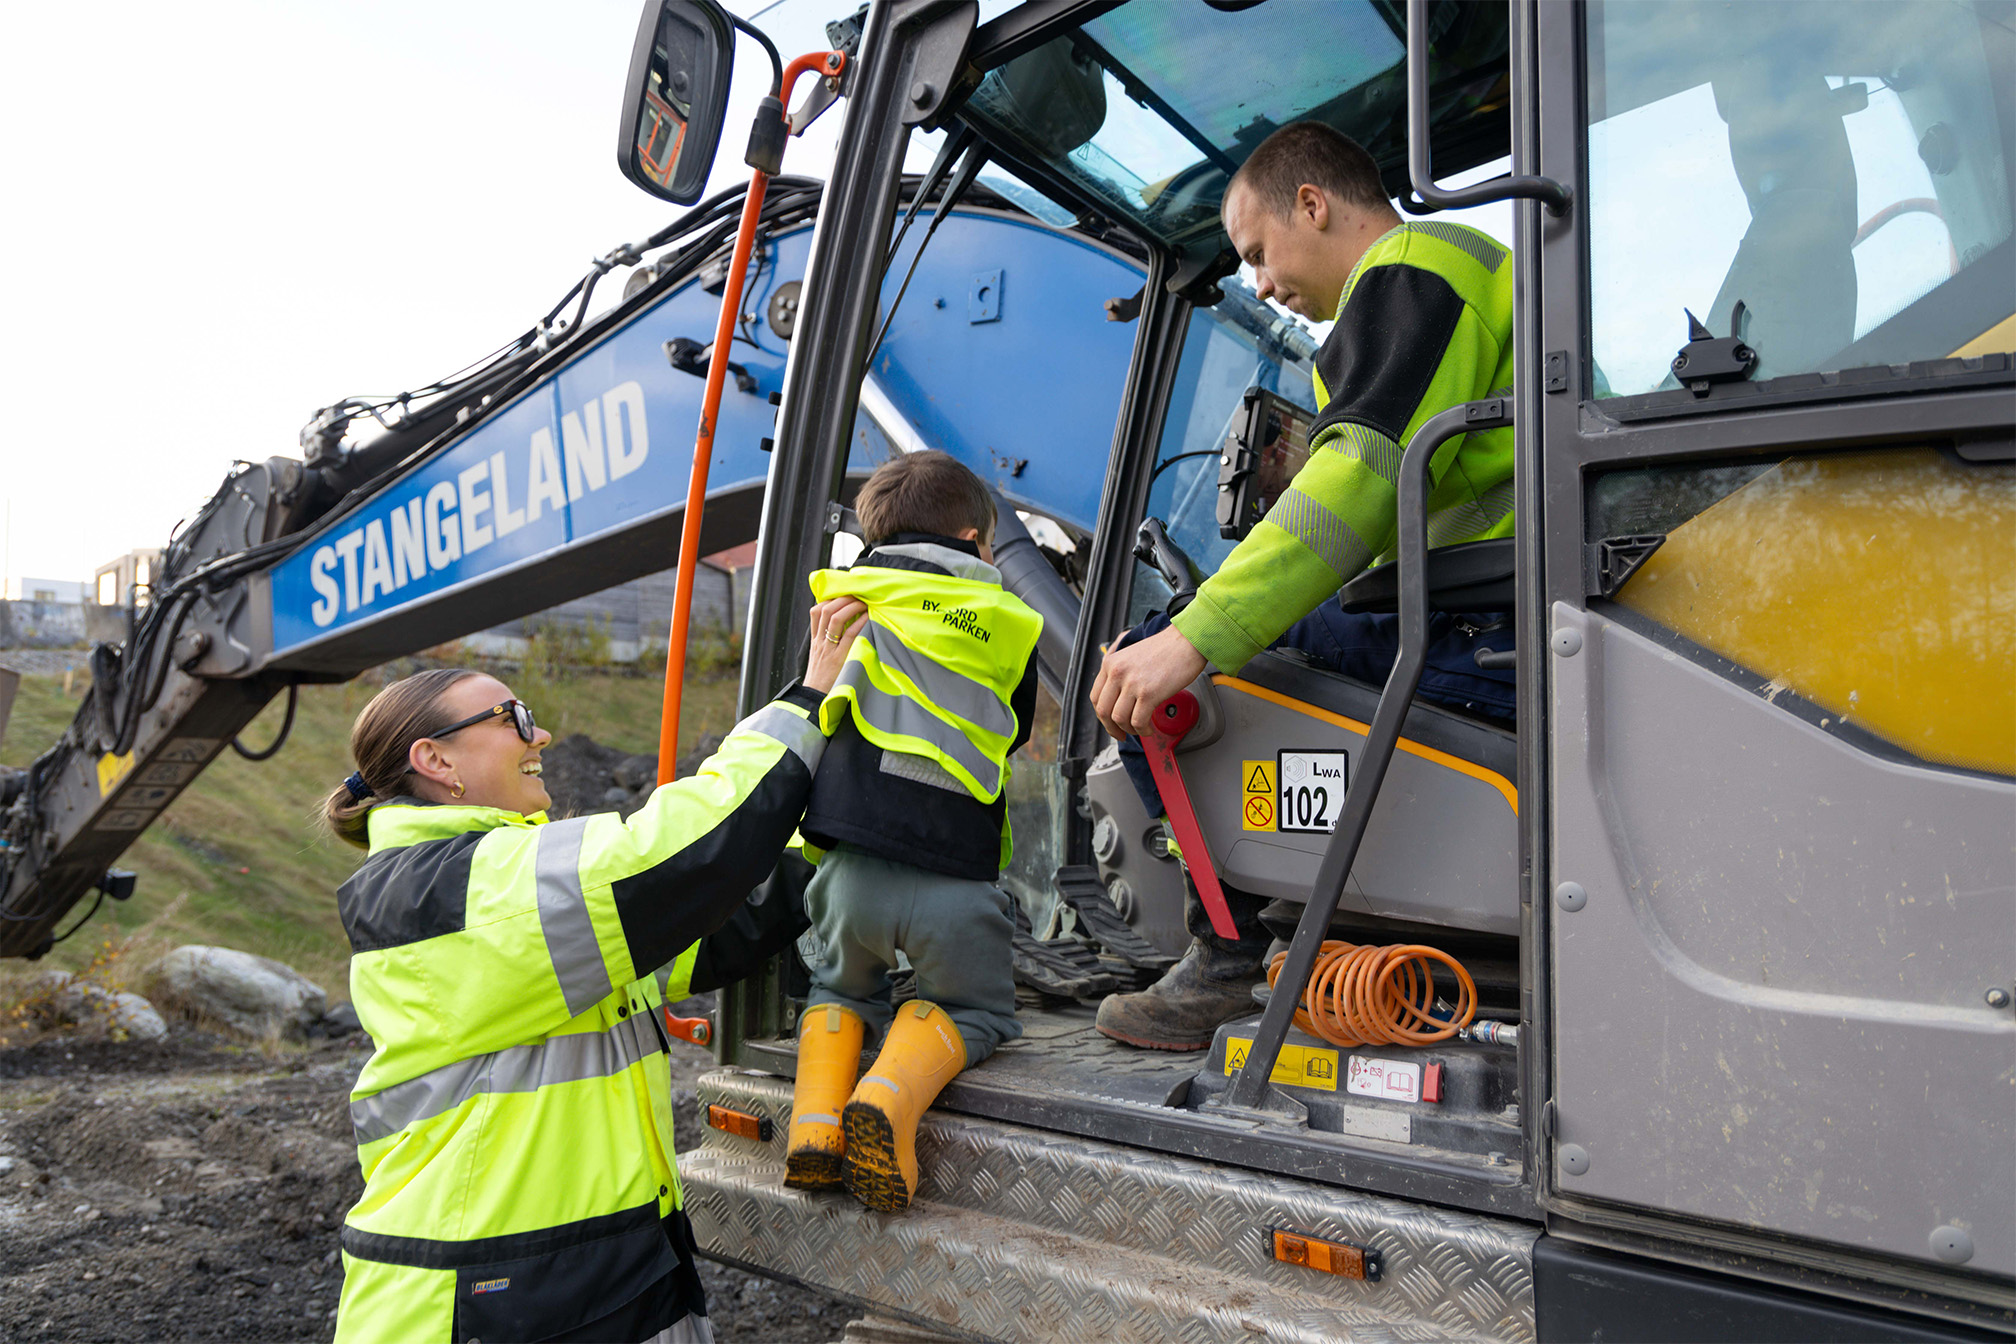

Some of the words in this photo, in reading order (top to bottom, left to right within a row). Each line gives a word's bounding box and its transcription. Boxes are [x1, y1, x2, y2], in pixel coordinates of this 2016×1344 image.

[310, 381, 649, 628] STANGELAND
[943, 613, 991, 643] PARKEN
[1283, 785, 1328, 827] 102
